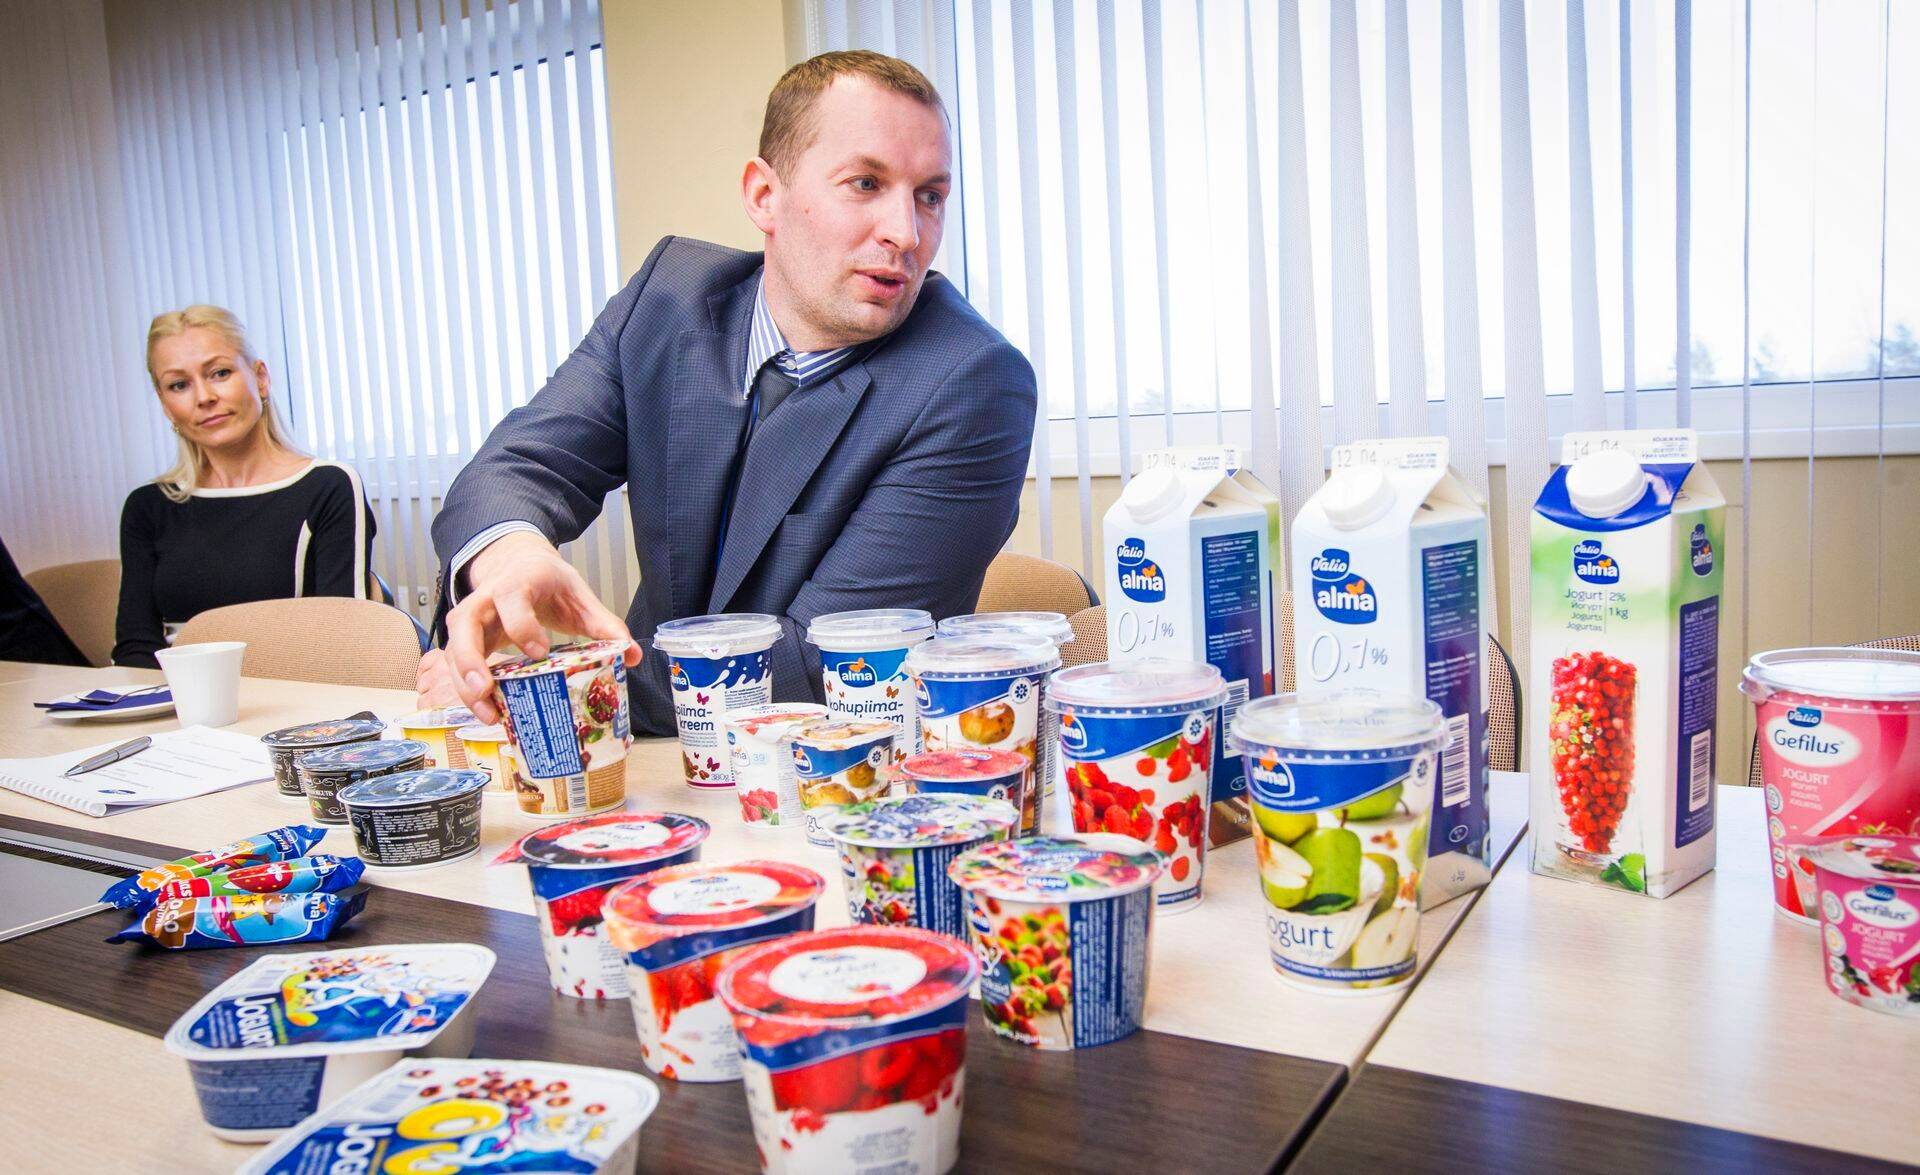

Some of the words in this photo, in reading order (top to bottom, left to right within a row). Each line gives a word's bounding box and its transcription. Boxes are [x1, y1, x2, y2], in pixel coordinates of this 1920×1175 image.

[1117, 544, 1144, 559] Valio
[1574, 544, 1601, 555] Valio
[1312, 556, 1348, 573] Valio
[1578, 561, 1618, 578] alma
[1122, 570, 1164, 592] alma
[1317, 585, 1375, 612] alma
[1565, 588, 1603, 602] Jogurt
[1609, 591, 1627, 602] 2%
[1571, 611, 1603, 622] Jogurts
[1609, 606, 1614, 617] 1
[1616, 606, 1629, 620] kg
[1567, 621, 1603, 633] Jogurtas
[841, 669, 873, 682] alma
[675, 703, 713, 718] piima-
[829, 700, 904, 716] kohupiima-
[680, 720, 714, 731] kreem
[1787, 710, 1820, 725] Valio
[1774, 728, 1840, 755] Gefilus
[1781, 766, 1831, 786] JOGURT
[309, 893, 321, 919] lma
[1849, 898, 1907, 922] Gefilus
[1267, 914, 1335, 949] ogurt
[329, 1122, 394, 1175] JOG
